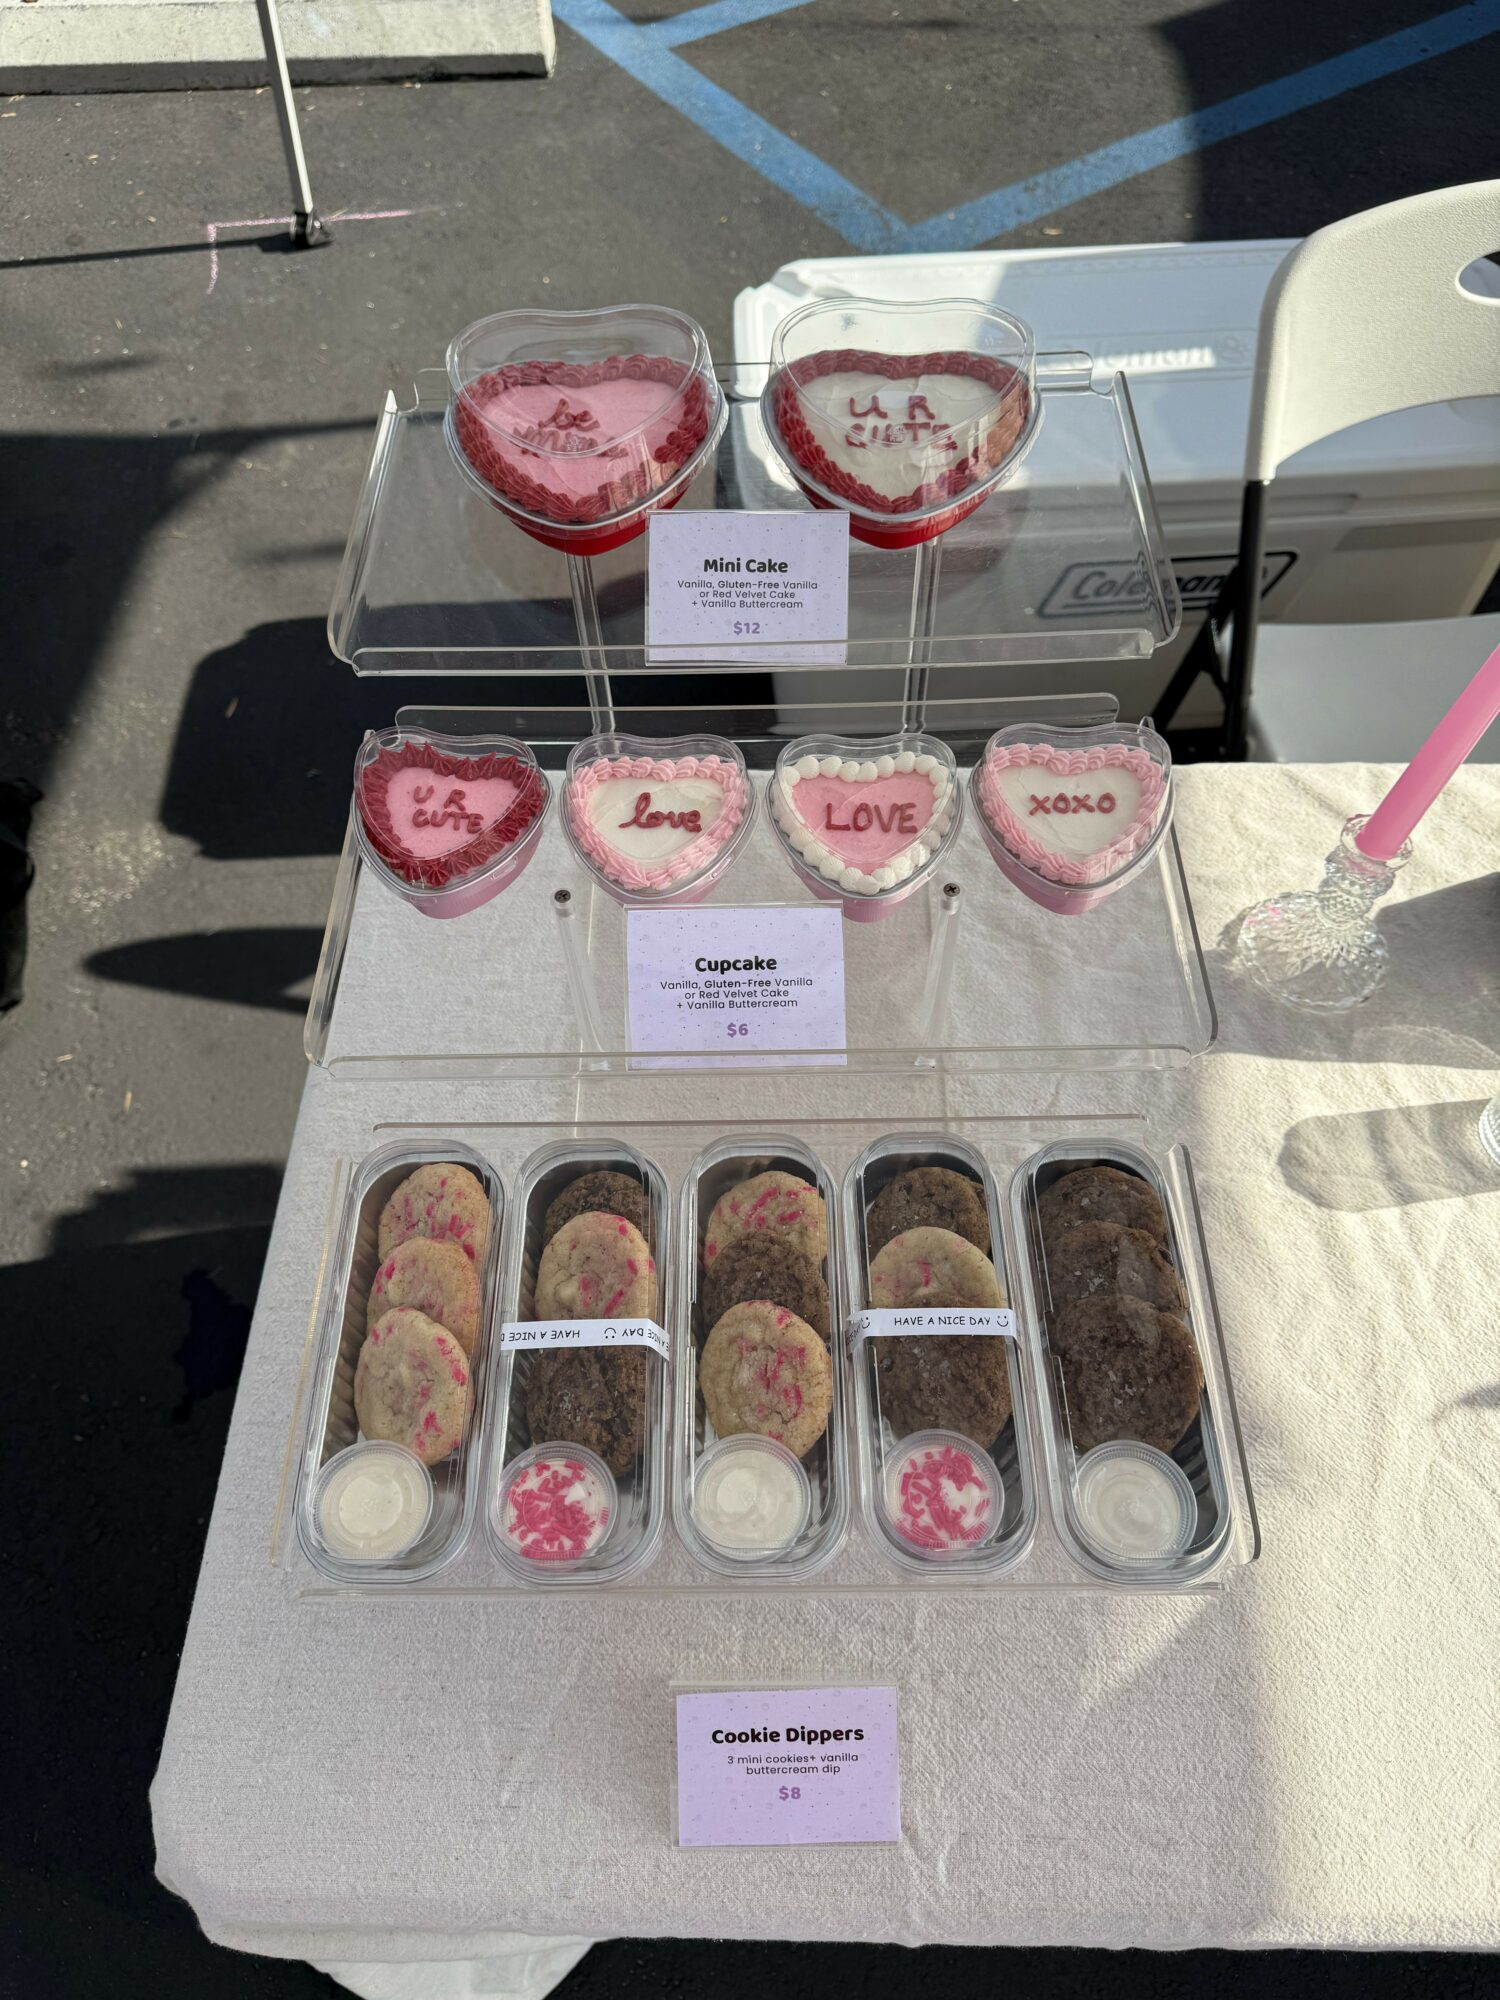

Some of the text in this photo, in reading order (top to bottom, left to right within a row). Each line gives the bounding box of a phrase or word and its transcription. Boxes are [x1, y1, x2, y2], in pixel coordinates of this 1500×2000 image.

[908, 395, 935, 420] R
[704, 557, 789, 573] Mini Cake
[677, 580, 818, 590] Vanilla, Gluten-Free Vanilla
[713, 590, 731, 598] Red
[735, 590, 766, 599] Velvet
[769, 591, 796, 599] Cake
[701, 599, 736, 608] Vanilla
[739, 600, 803, 609] Buttercream
[733, 621, 760, 635] $12
[414, 785, 466, 811] U R
[618, 792, 702, 832] love
[825, 802, 918, 834] LOVE
[412, 808, 484, 834] CUTE
[695, 956, 777, 975] Cupcake
[660, 977, 813, 990] Vanilla, Gluten-Free Vanilla
[684, 989, 789, 1000] or Red Velvet Cake
[687, 1001, 725, 1010] Vanilla
[729, 999, 798, 1009] Buttercream
[727, 1022, 749, 1038] $6
[894, 1316, 991, 1326] HAVE A NICE DAY
[509, 1332, 536, 1341] NICE
[540, 1331, 547, 1339] A
[551, 1330, 580, 1339] HAVE
[622, 1328, 644, 1337] DAY
[647, 1329, 661, 1346] NICE
[711, 1726, 865, 1745] Cookie Dippers
[727, 1753, 859, 1765] 3 mini cookies+ vanilla
[746, 1764, 841, 1775] buttercream dip
[779, 1785, 801, 1801] $8
